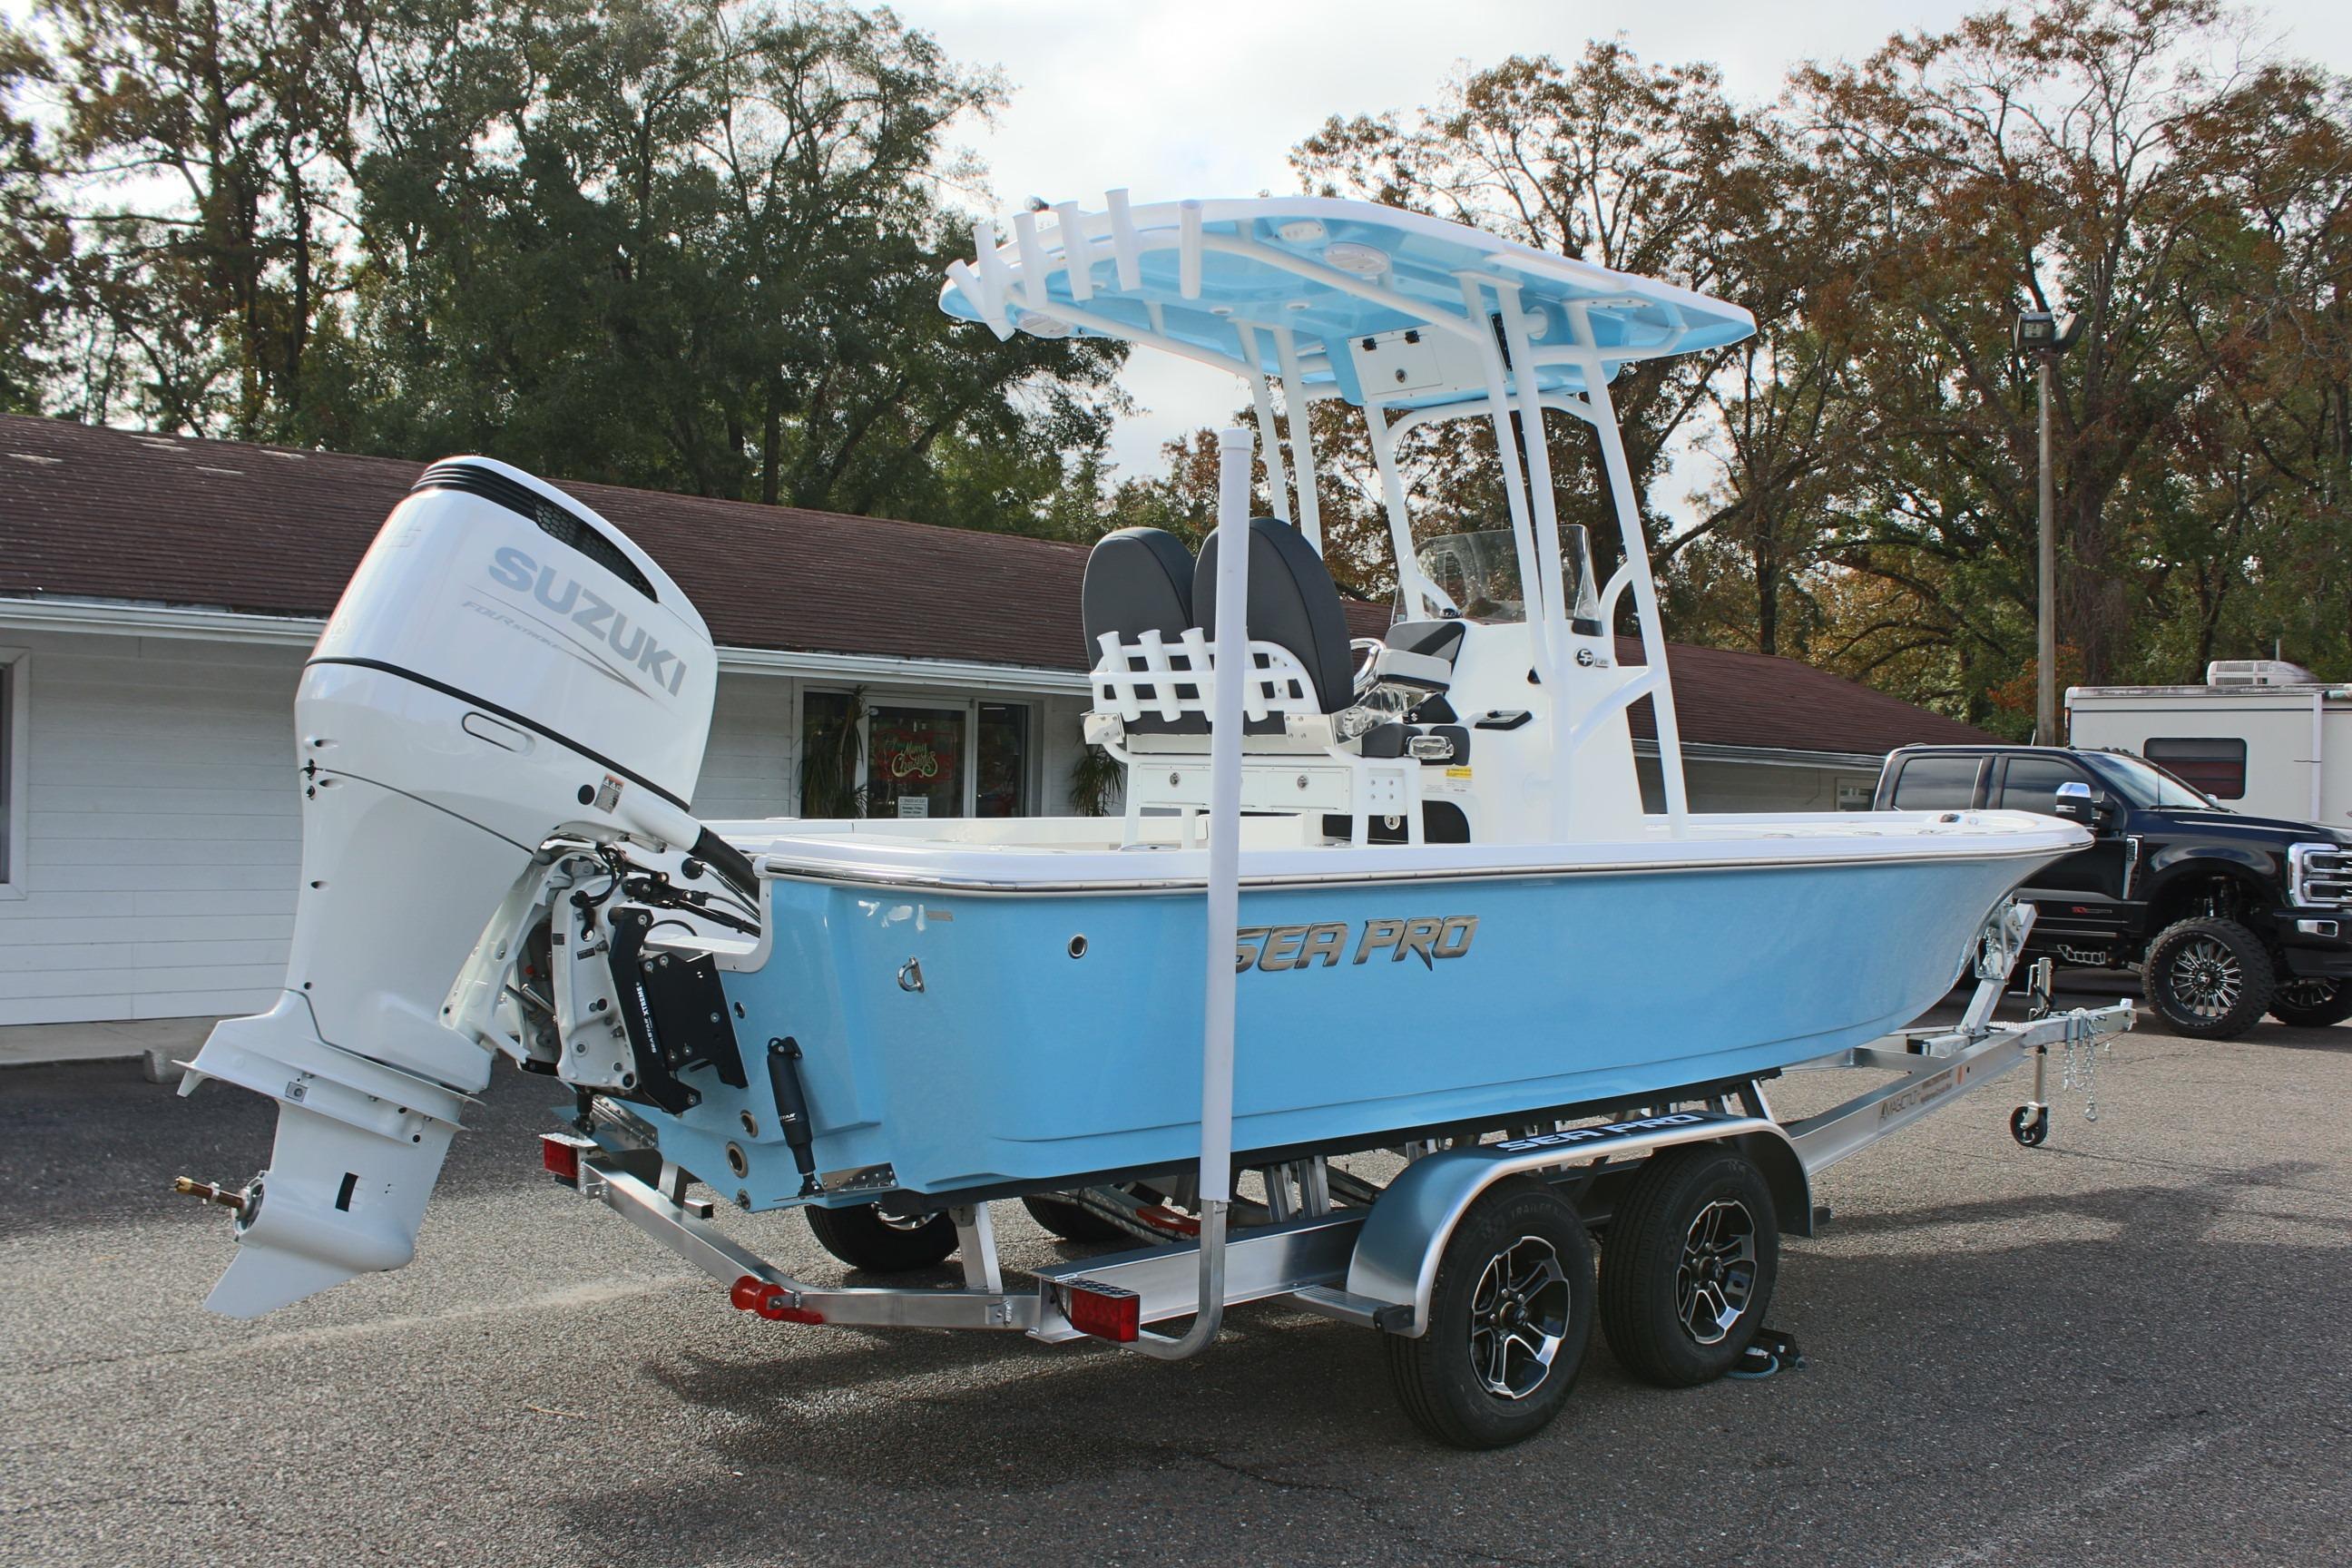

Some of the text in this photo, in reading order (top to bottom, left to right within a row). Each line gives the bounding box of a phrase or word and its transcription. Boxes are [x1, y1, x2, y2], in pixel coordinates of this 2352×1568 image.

[488, 546, 687, 697] SUZUKI
[1235, 914, 1479, 973] SEA PRO
[1496, 1113, 1705, 1152] SEA PRO
